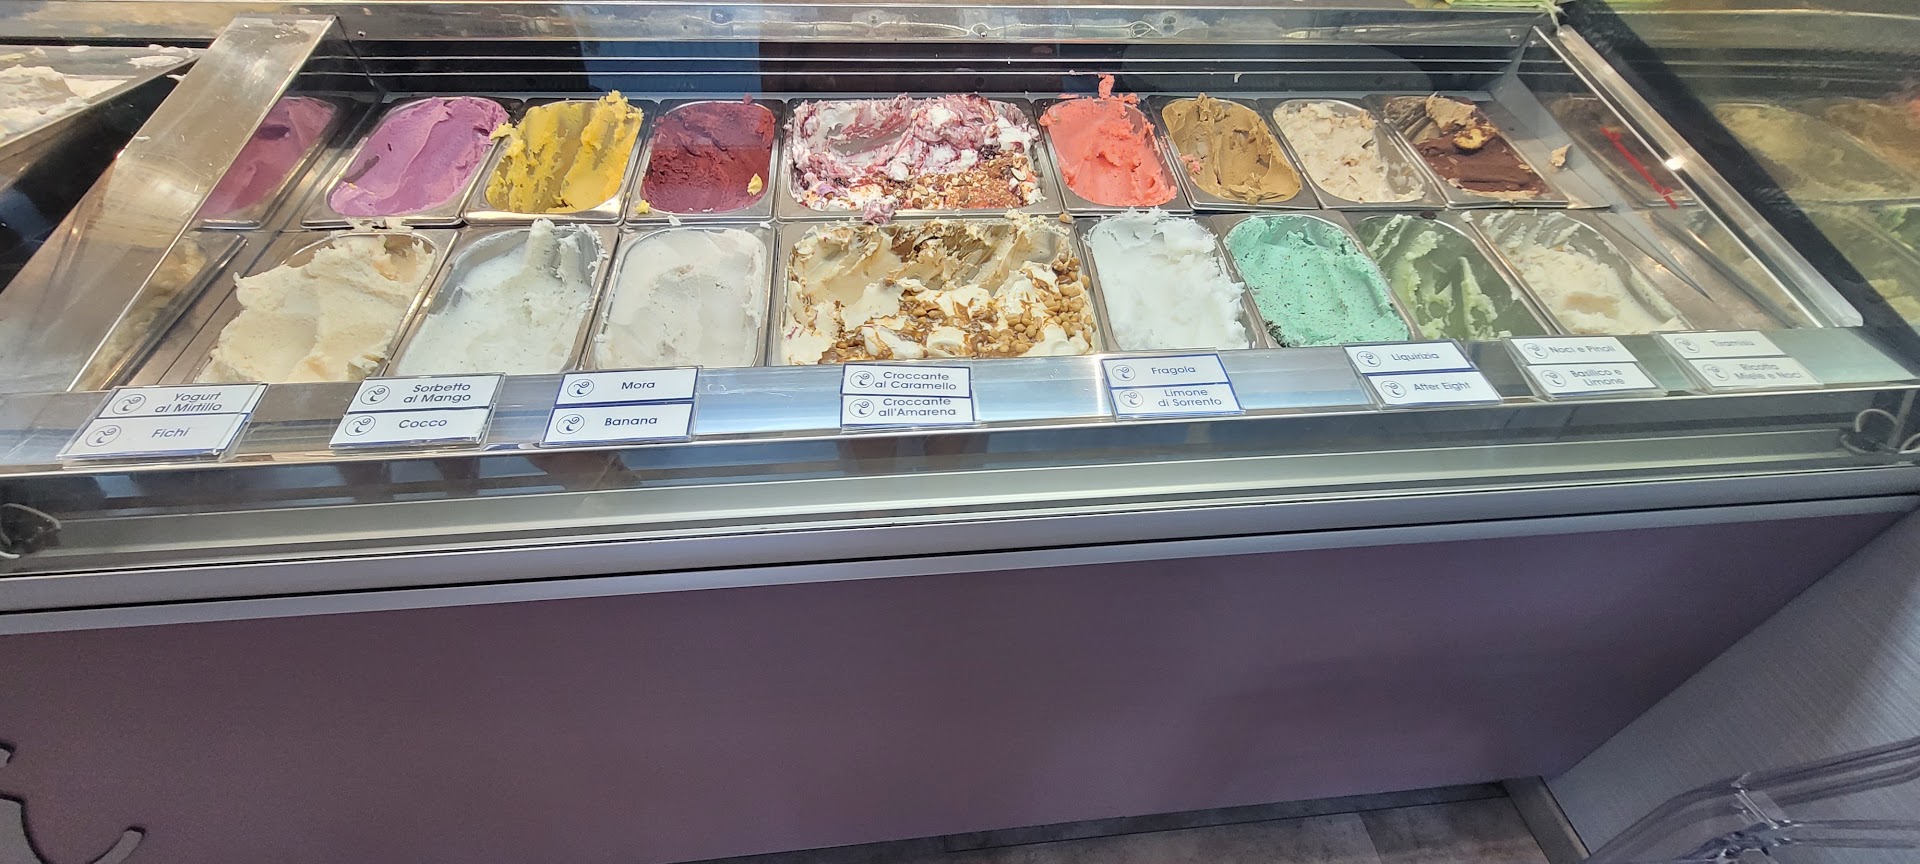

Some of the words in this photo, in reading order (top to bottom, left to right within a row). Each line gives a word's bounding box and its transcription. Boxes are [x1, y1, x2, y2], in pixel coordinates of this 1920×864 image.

[1548, 346, 1576, 354] Noci
[1586, 344, 1616, 353] Pinoli
[1391, 352, 1440, 362] Liquirizia
[1151, 366, 1196, 375] Fragola
[1569, 369, 1613, 378] Basilico
[883, 371, 949, 381] Croccante
[621, 381, 656, 390] Mora
[874, 381, 887, 389] al
[890, 381, 957, 390] Caramello
[1413, 381, 1440, 391] After
[1442, 381, 1471, 392] Eight
[1583, 378, 1626, 386] Limone
[412, 382, 471, 393] Sorbetto
[174, 392, 222, 403] Yogurt
[1164, 389, 1208, 397] Limone
[403, 394, 416, 404] al
[421, 393, 471, 404] Mango
[882, 397, 952, 406] Croccante
[1157, 398, 1170, 407] di
[1172, 397, 1222, 407] Sorrento
[154, 403, 171, 413] al
[878, 408, 956, 417] all'Amarena
[398, 419, 448, 429] Cocco
[604, 416, 658, 427] Banana
[151, 427, 191, 438] Fichi
